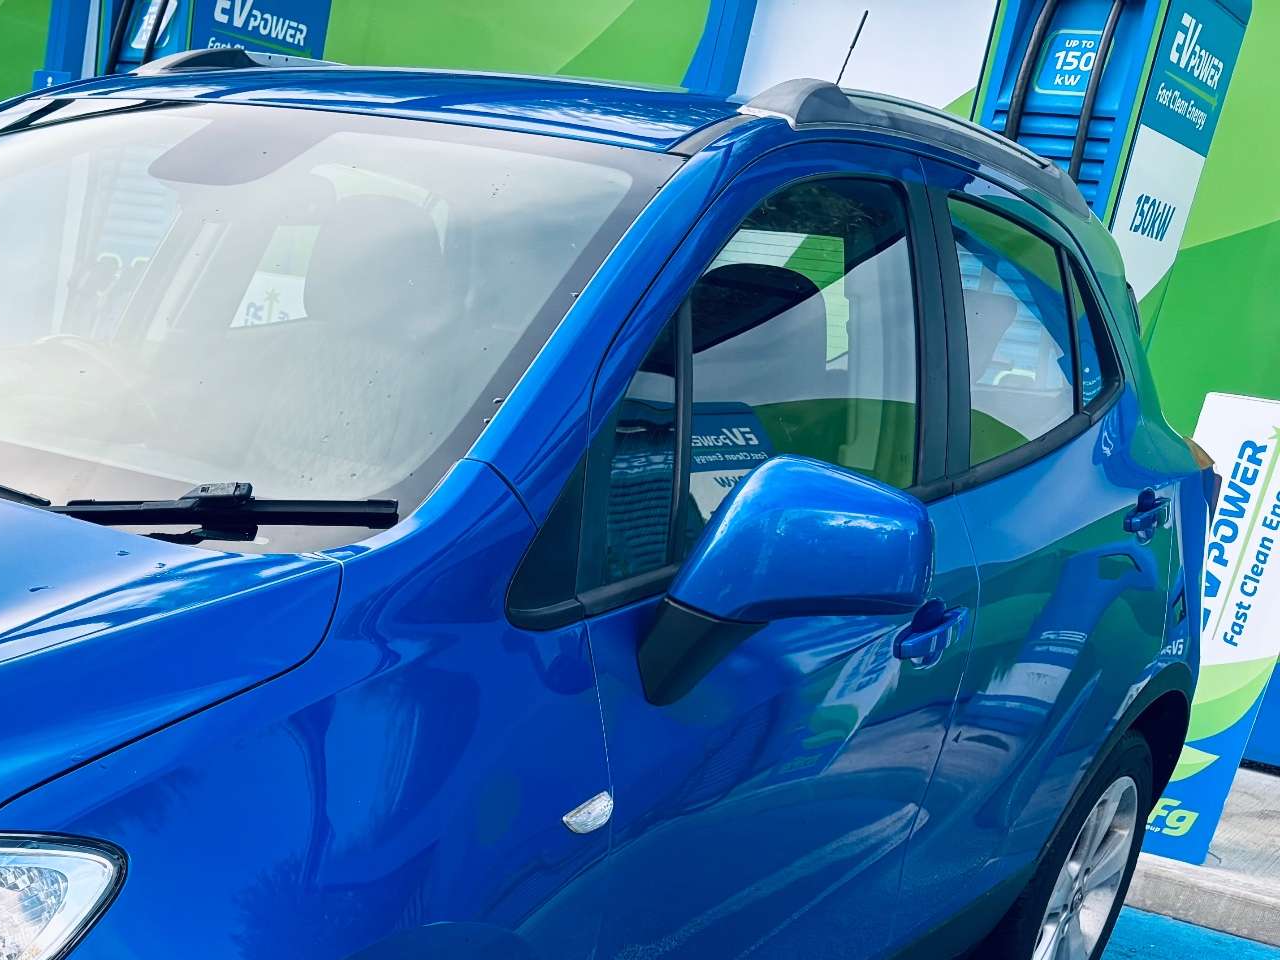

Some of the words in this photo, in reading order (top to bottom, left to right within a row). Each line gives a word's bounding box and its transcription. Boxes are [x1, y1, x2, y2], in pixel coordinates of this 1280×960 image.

[1065, 39, 1080, 48] UP
[1081, 39, 1095, 49] TO
[1055, 50, 1097, 72] 150
[1053, 73, 1082, 86] kW
[1129, 193, 1176, 242] 150kW
[1223, 600, 1252, 647] Fast
[1239, 536, 1275, 598] Clean
